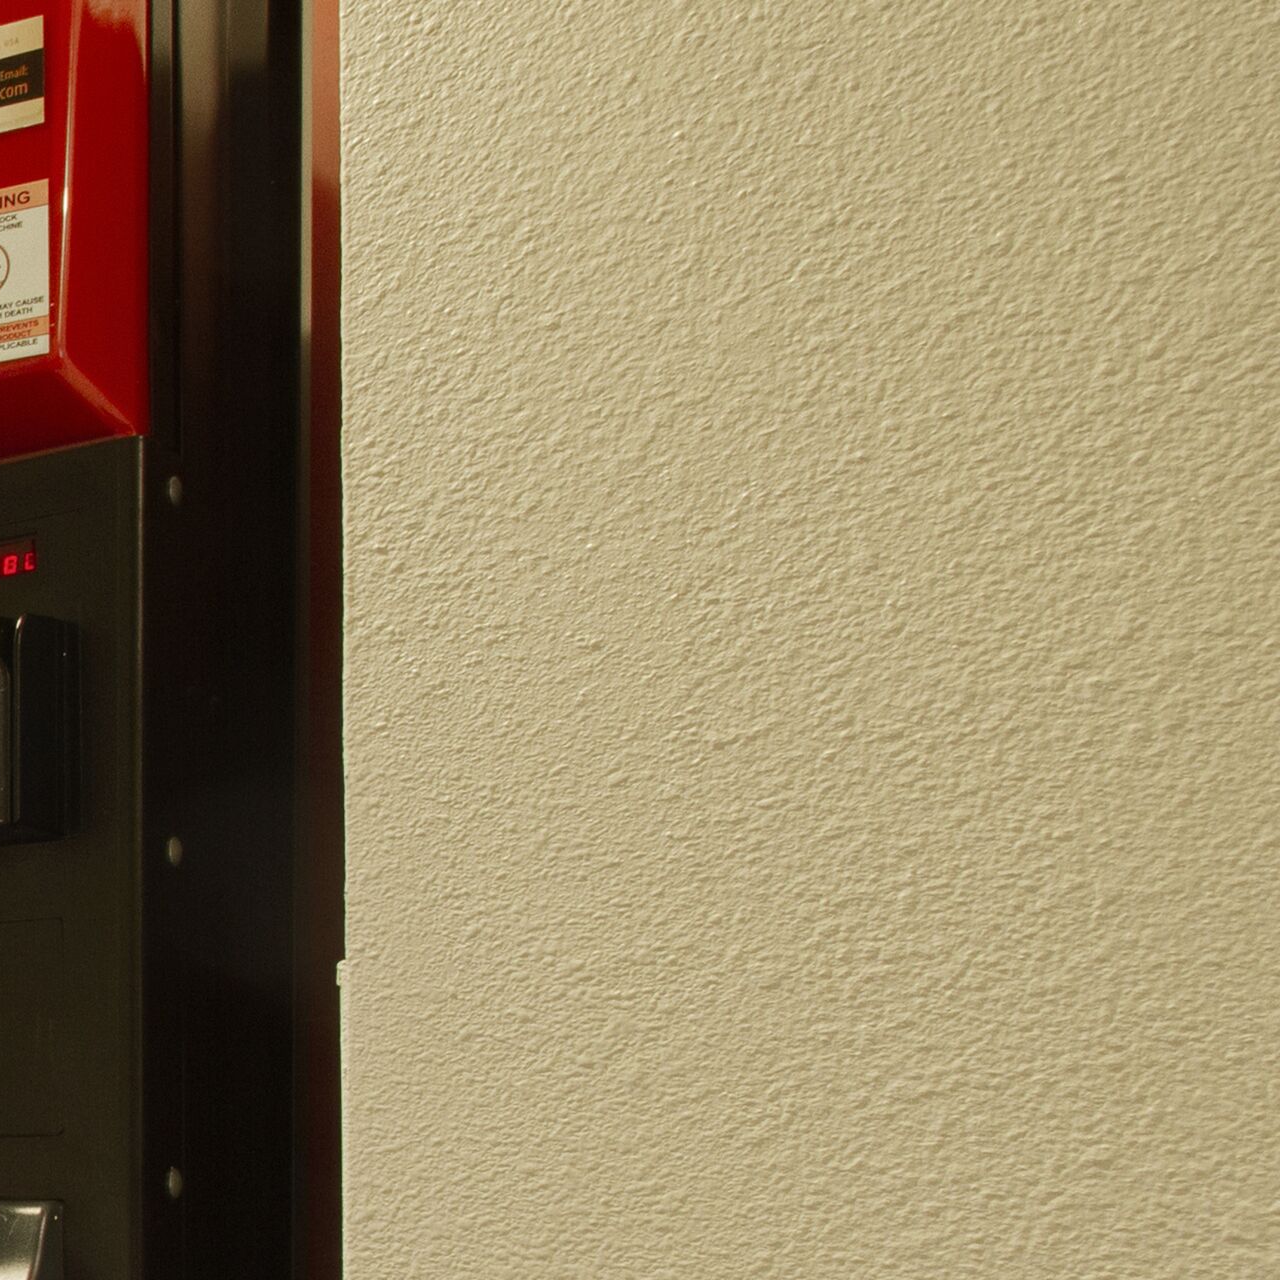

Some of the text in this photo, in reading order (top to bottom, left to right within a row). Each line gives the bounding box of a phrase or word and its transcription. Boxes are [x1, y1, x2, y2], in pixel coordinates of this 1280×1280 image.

[0, 64, 30, 83] Email:
[15, 295, 45, 308] CAUSE
[4, 307, 34, 319] DEATH
